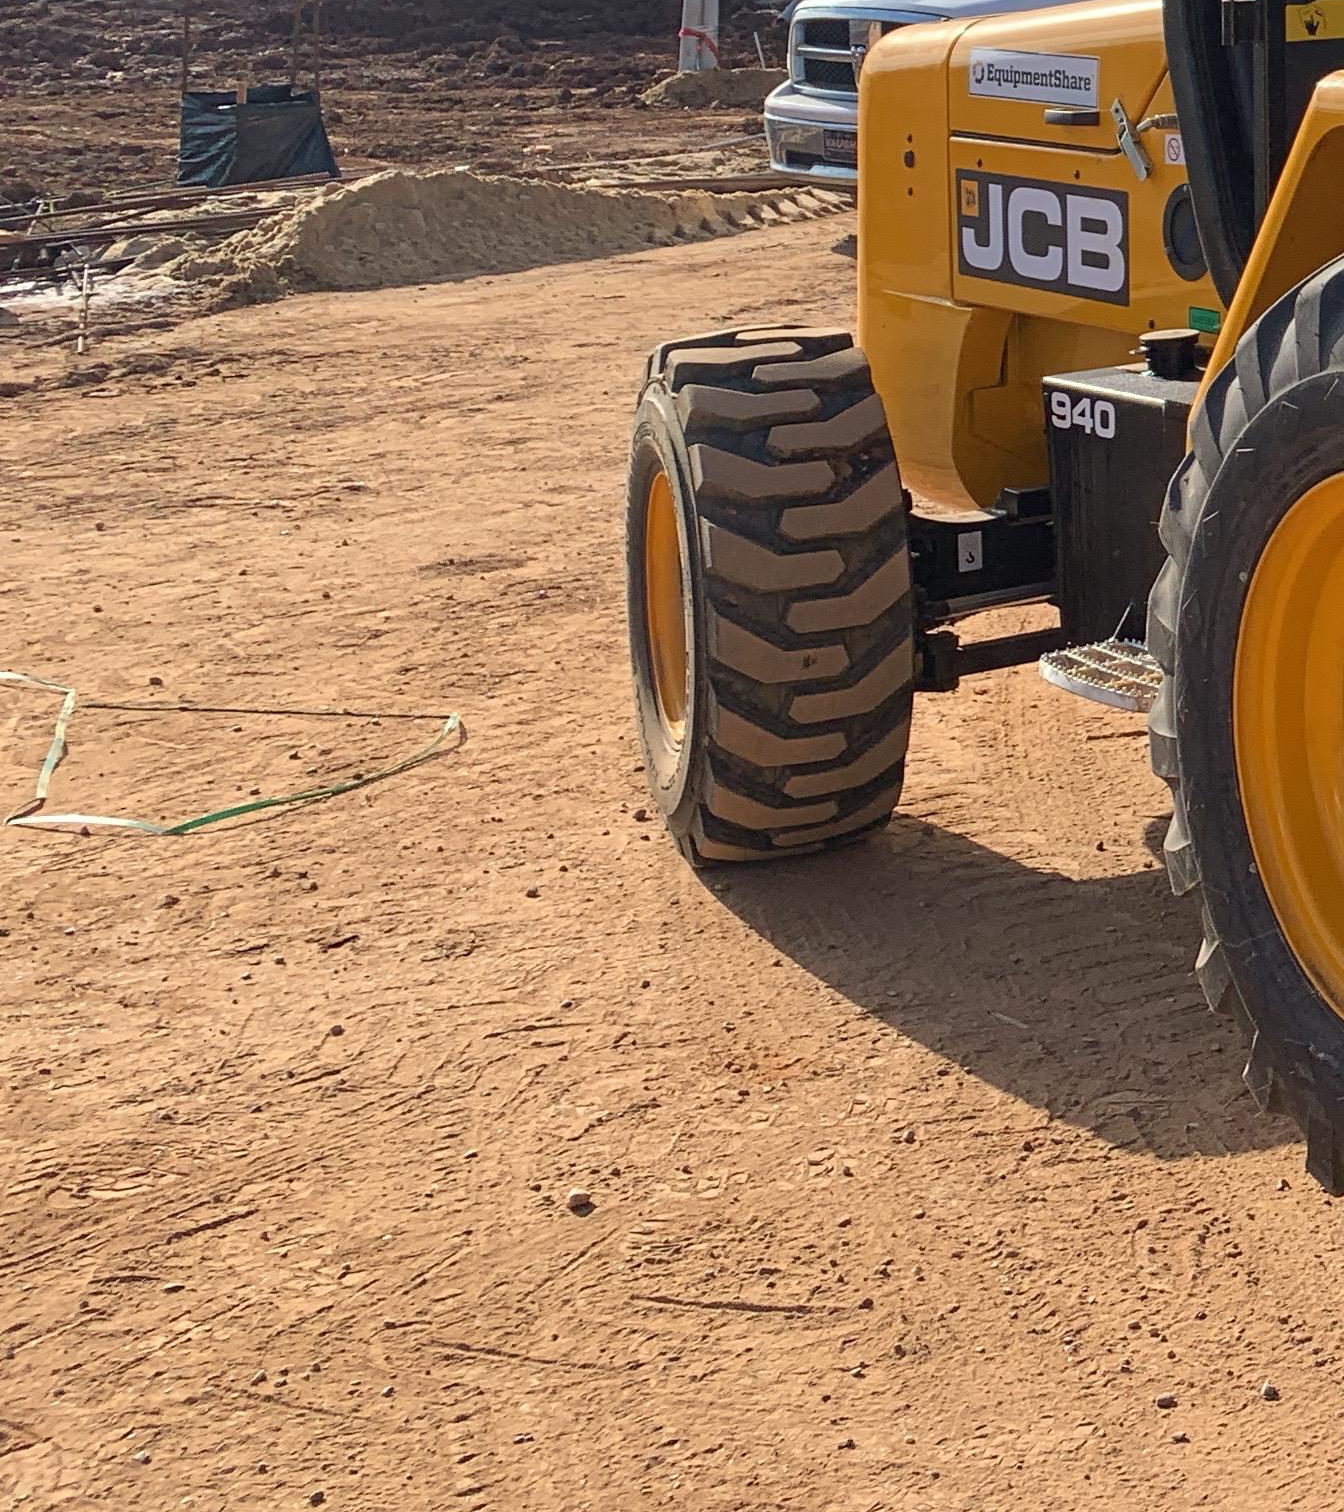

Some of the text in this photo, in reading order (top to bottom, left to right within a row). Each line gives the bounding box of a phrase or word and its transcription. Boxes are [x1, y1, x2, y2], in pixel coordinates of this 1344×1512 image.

[986, 63, 1092, 92] EquipmentShare
[961, 183, 1126, 293] JCB
[1051, 391, 1116, 439] 940
